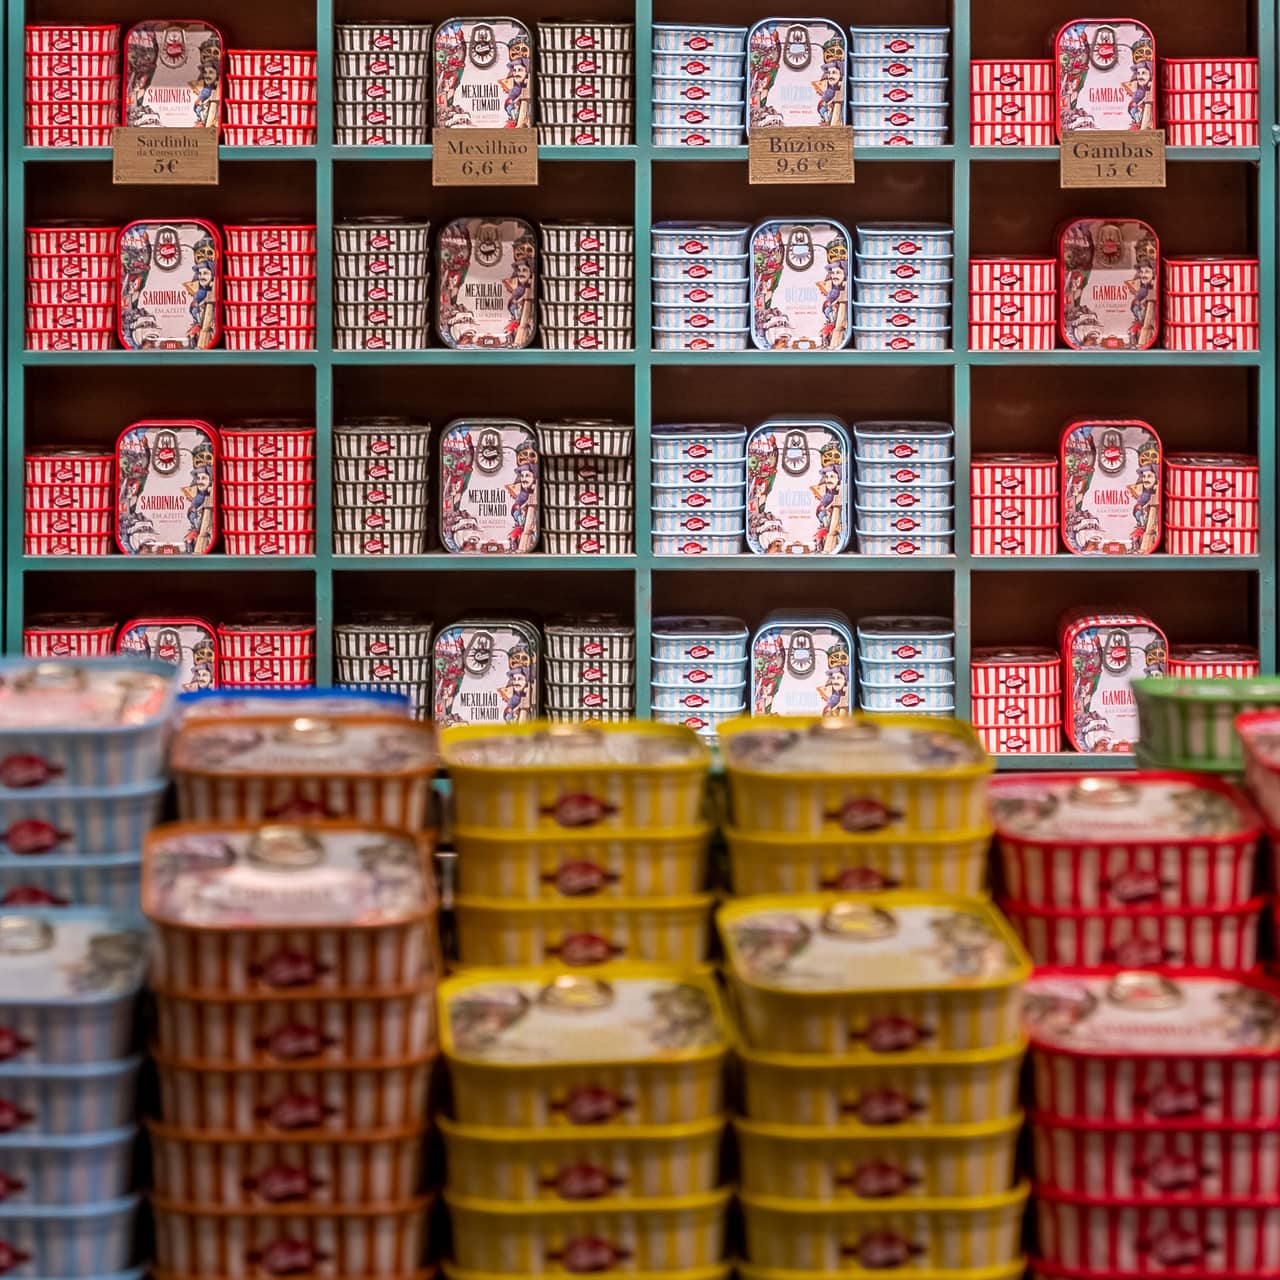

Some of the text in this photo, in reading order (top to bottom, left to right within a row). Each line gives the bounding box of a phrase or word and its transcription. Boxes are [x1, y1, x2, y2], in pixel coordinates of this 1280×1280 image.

[148, 88, 191, 103] SARDINHAS
[461, 83, 498, 99] MEXILHÃO
[1089, 87, 1124, 103] GAMBAS
[472, 100, 500, 112] FUMADO
[137, 136, 198, 147] Sardinha
[448, 140, 527, 155] Mexilhão
[770, 136, 835, 152] Búzios
[1073, 143, 1153, 159] Gambas
[154, 159, 178, 174] 5€
[462, 161, 513, 176] 6,6 €
[777, 158, 828, 173] 9,6 €
[1097, 163, 1137, 177] 15 €
[465, 282, 502, 298] MEXILHÃO
[1093, 285, 1127, 301] GAMBAS
[143, 291, 186, 305] SARDINHAS
[476, 298, 503, 310] FUMADO
[141, 496, 184, 510] SARDINHAS
[468, 489, 505, 504] MEXILHÃO
[1095, 490, 1129, 506] GAMBAS
[479, 505, 507, 517] FUMADO
[461, 693, 497, 707] MEXILHÃO
[1102, 689, 1136, 705] GAMBA
[471, 708, 499, 720] FUMADO
